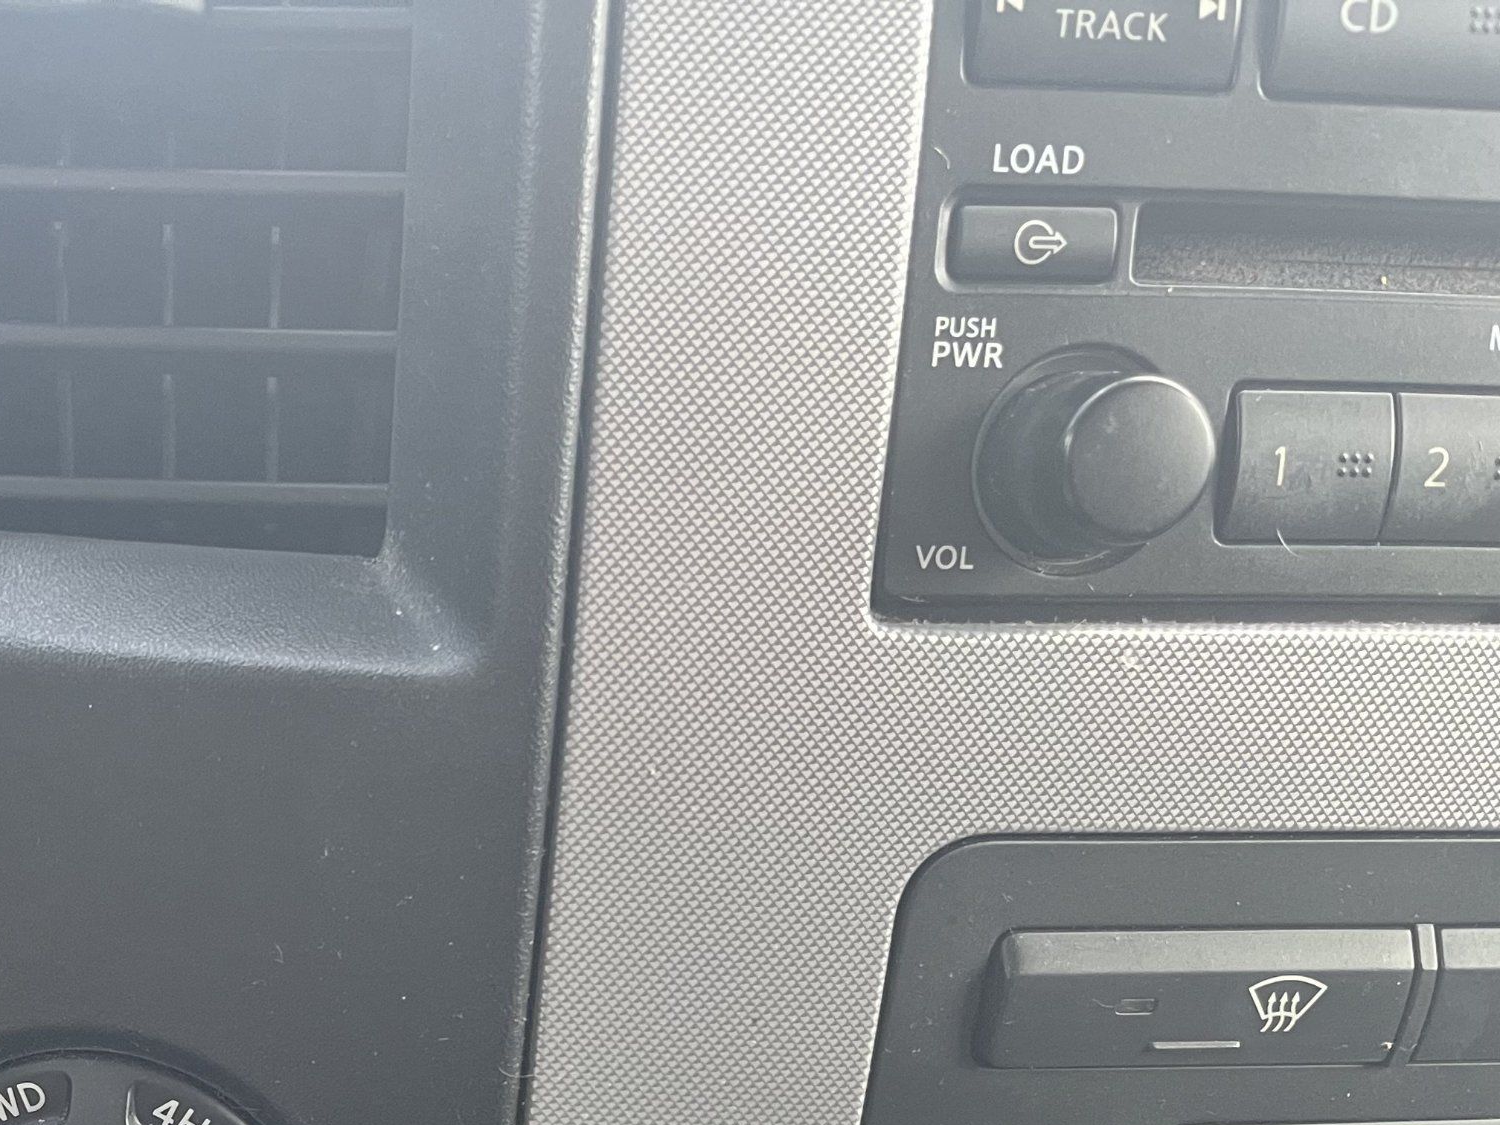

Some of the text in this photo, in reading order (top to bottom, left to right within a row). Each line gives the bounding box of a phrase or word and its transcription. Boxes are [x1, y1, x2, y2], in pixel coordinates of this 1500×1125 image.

[1056, 9, 1168, 41] TRACK
[1340, 0, 1398, 33] CD
[993, 144, 1084, 174] LOAD
[935, 317, 996, 338] PUSH
[931, 342, 1003, 368] PWR
[1274, 447, 1288, 486] 1
[1423, 448, 1449, 488] 2
[917, 545, 974, 570] VOL
